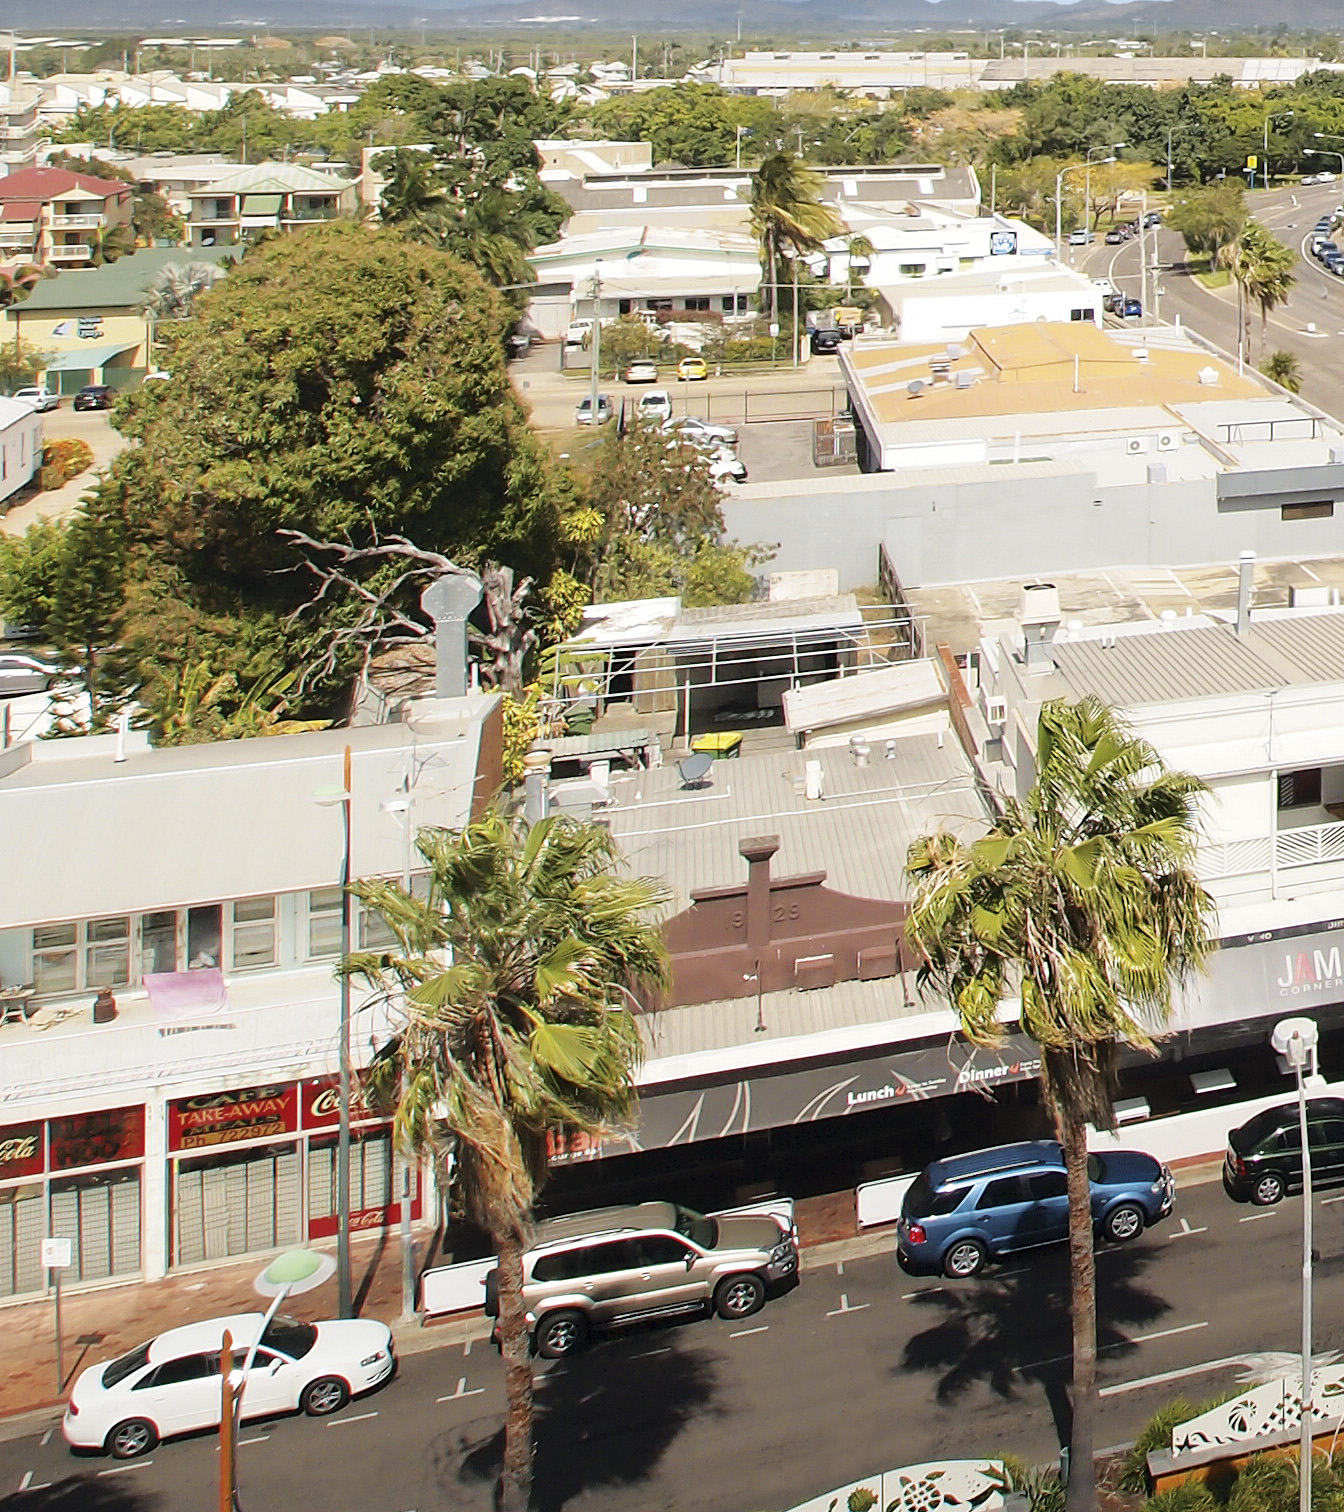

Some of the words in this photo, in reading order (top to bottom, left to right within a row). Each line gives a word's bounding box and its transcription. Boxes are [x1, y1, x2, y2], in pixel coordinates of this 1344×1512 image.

[1277, 947, 1342, 987] JAM
[1280, 978, 1343, 997] CORNER
[959, 1065, 1009, 1084] Dinner
[180, 1088, 283, 1111] CAFE
[847, 1086, 895, 1105] Lunch
[177, 1096, 290, 1126] TAKE-AWAY
[184, 1136, 206, 1148] Ph
[220, 1121, 281, 1143] 722972
